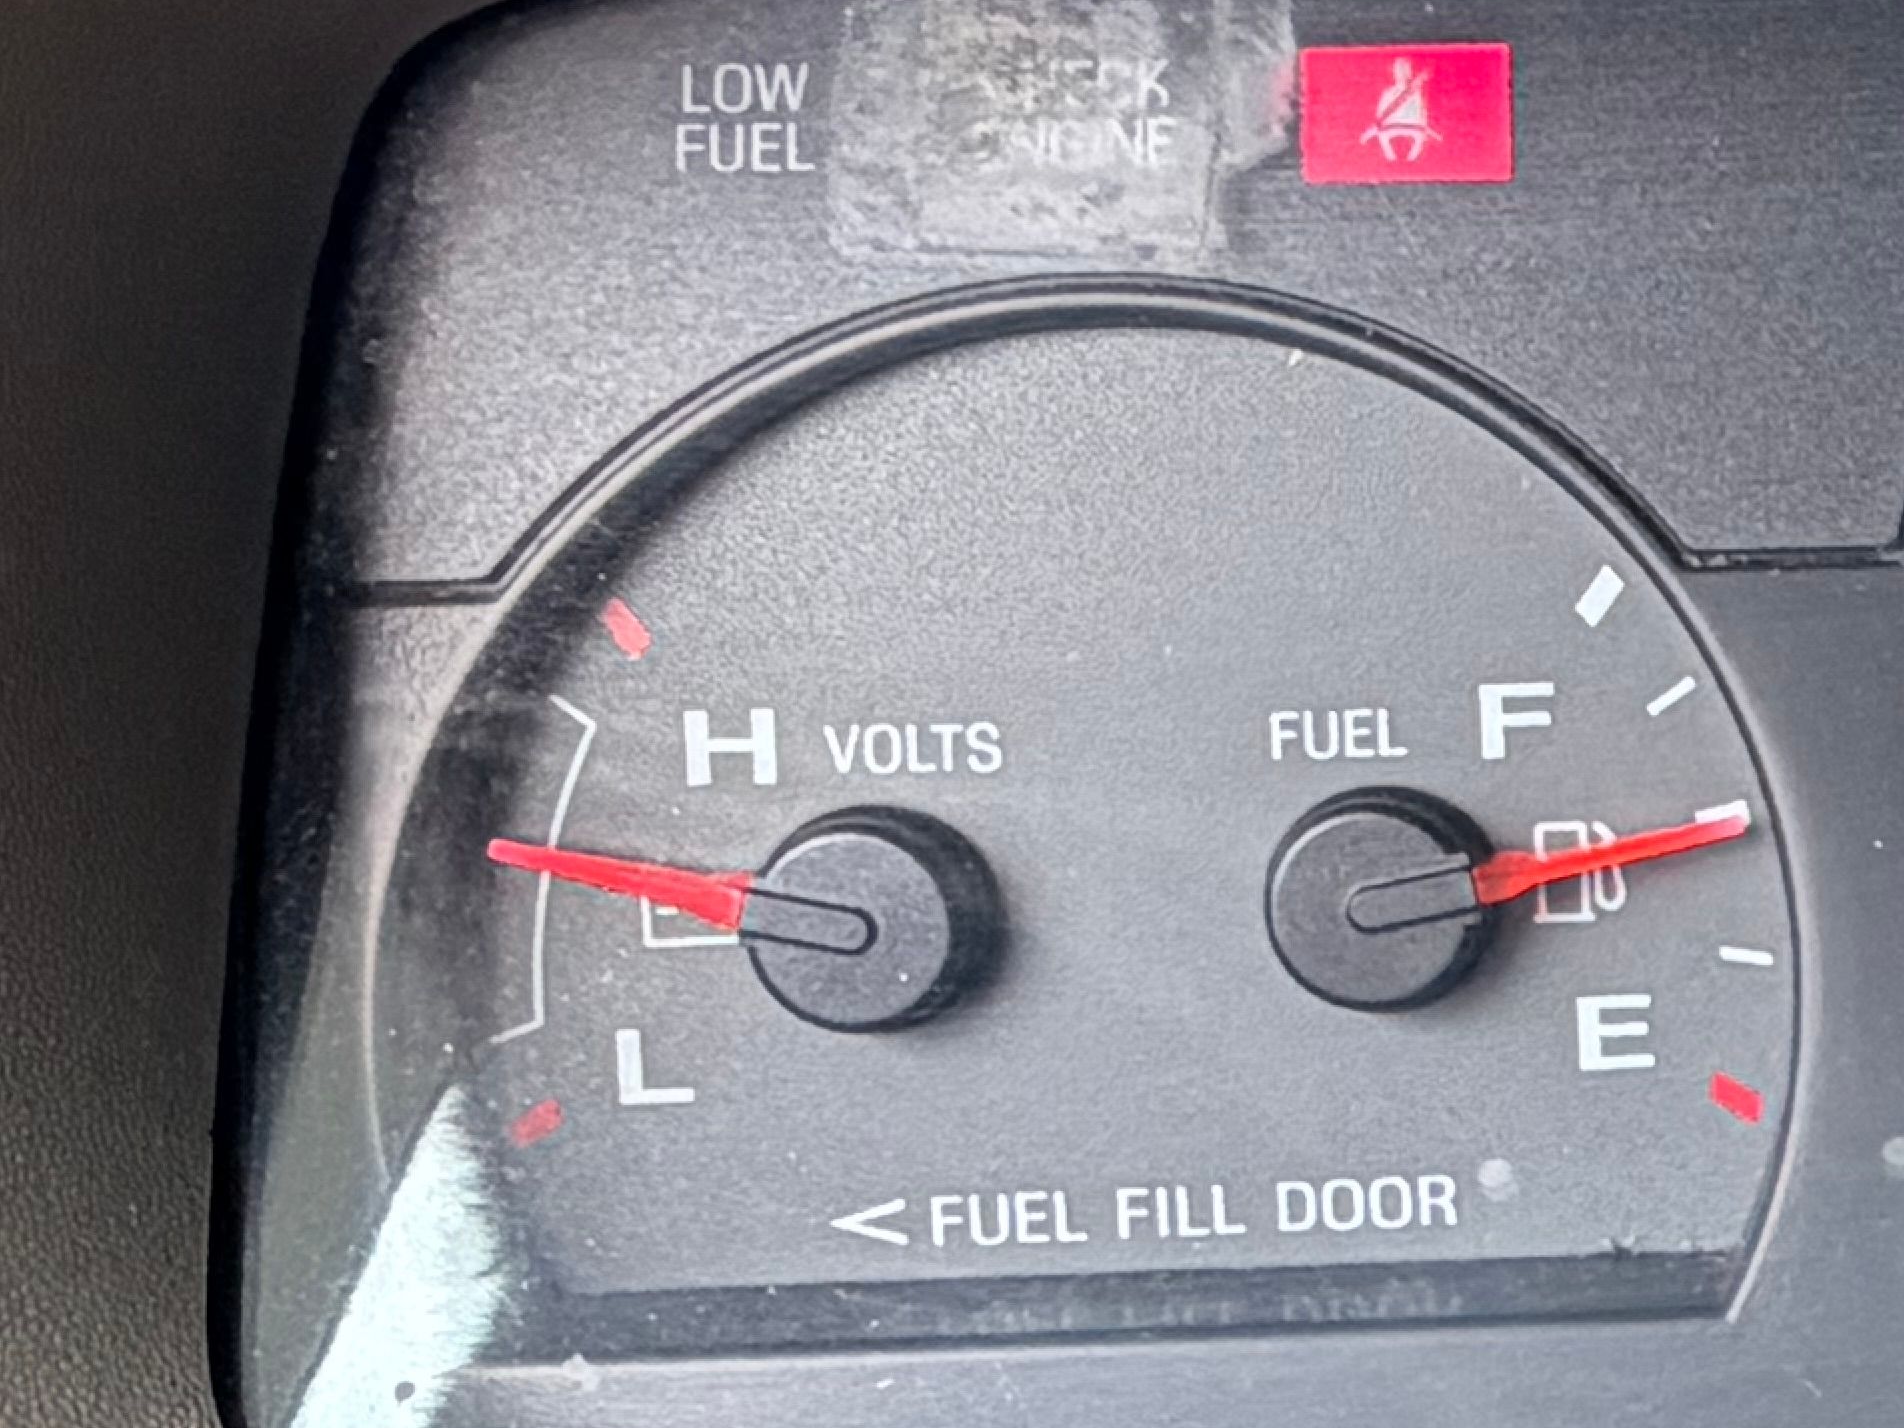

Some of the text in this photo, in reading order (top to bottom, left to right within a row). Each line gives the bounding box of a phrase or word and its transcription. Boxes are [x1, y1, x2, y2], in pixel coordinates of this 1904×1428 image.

[681, 62, 809, 114] LOW
[975, 59, 1170, 109] HECK
[675, 121, 816, 174] FUEL
[969, 117, 1178, 169] NGINE
[683, 707, 1003, 787] H VOLTS
[1268, 681, 1555, 761] FUEL F
[615, 1028, 696, 1105] L
[1575, 994, 1656, 1072] E
[930, 1174, 1458, 1248] FUEL FILL DOOR
